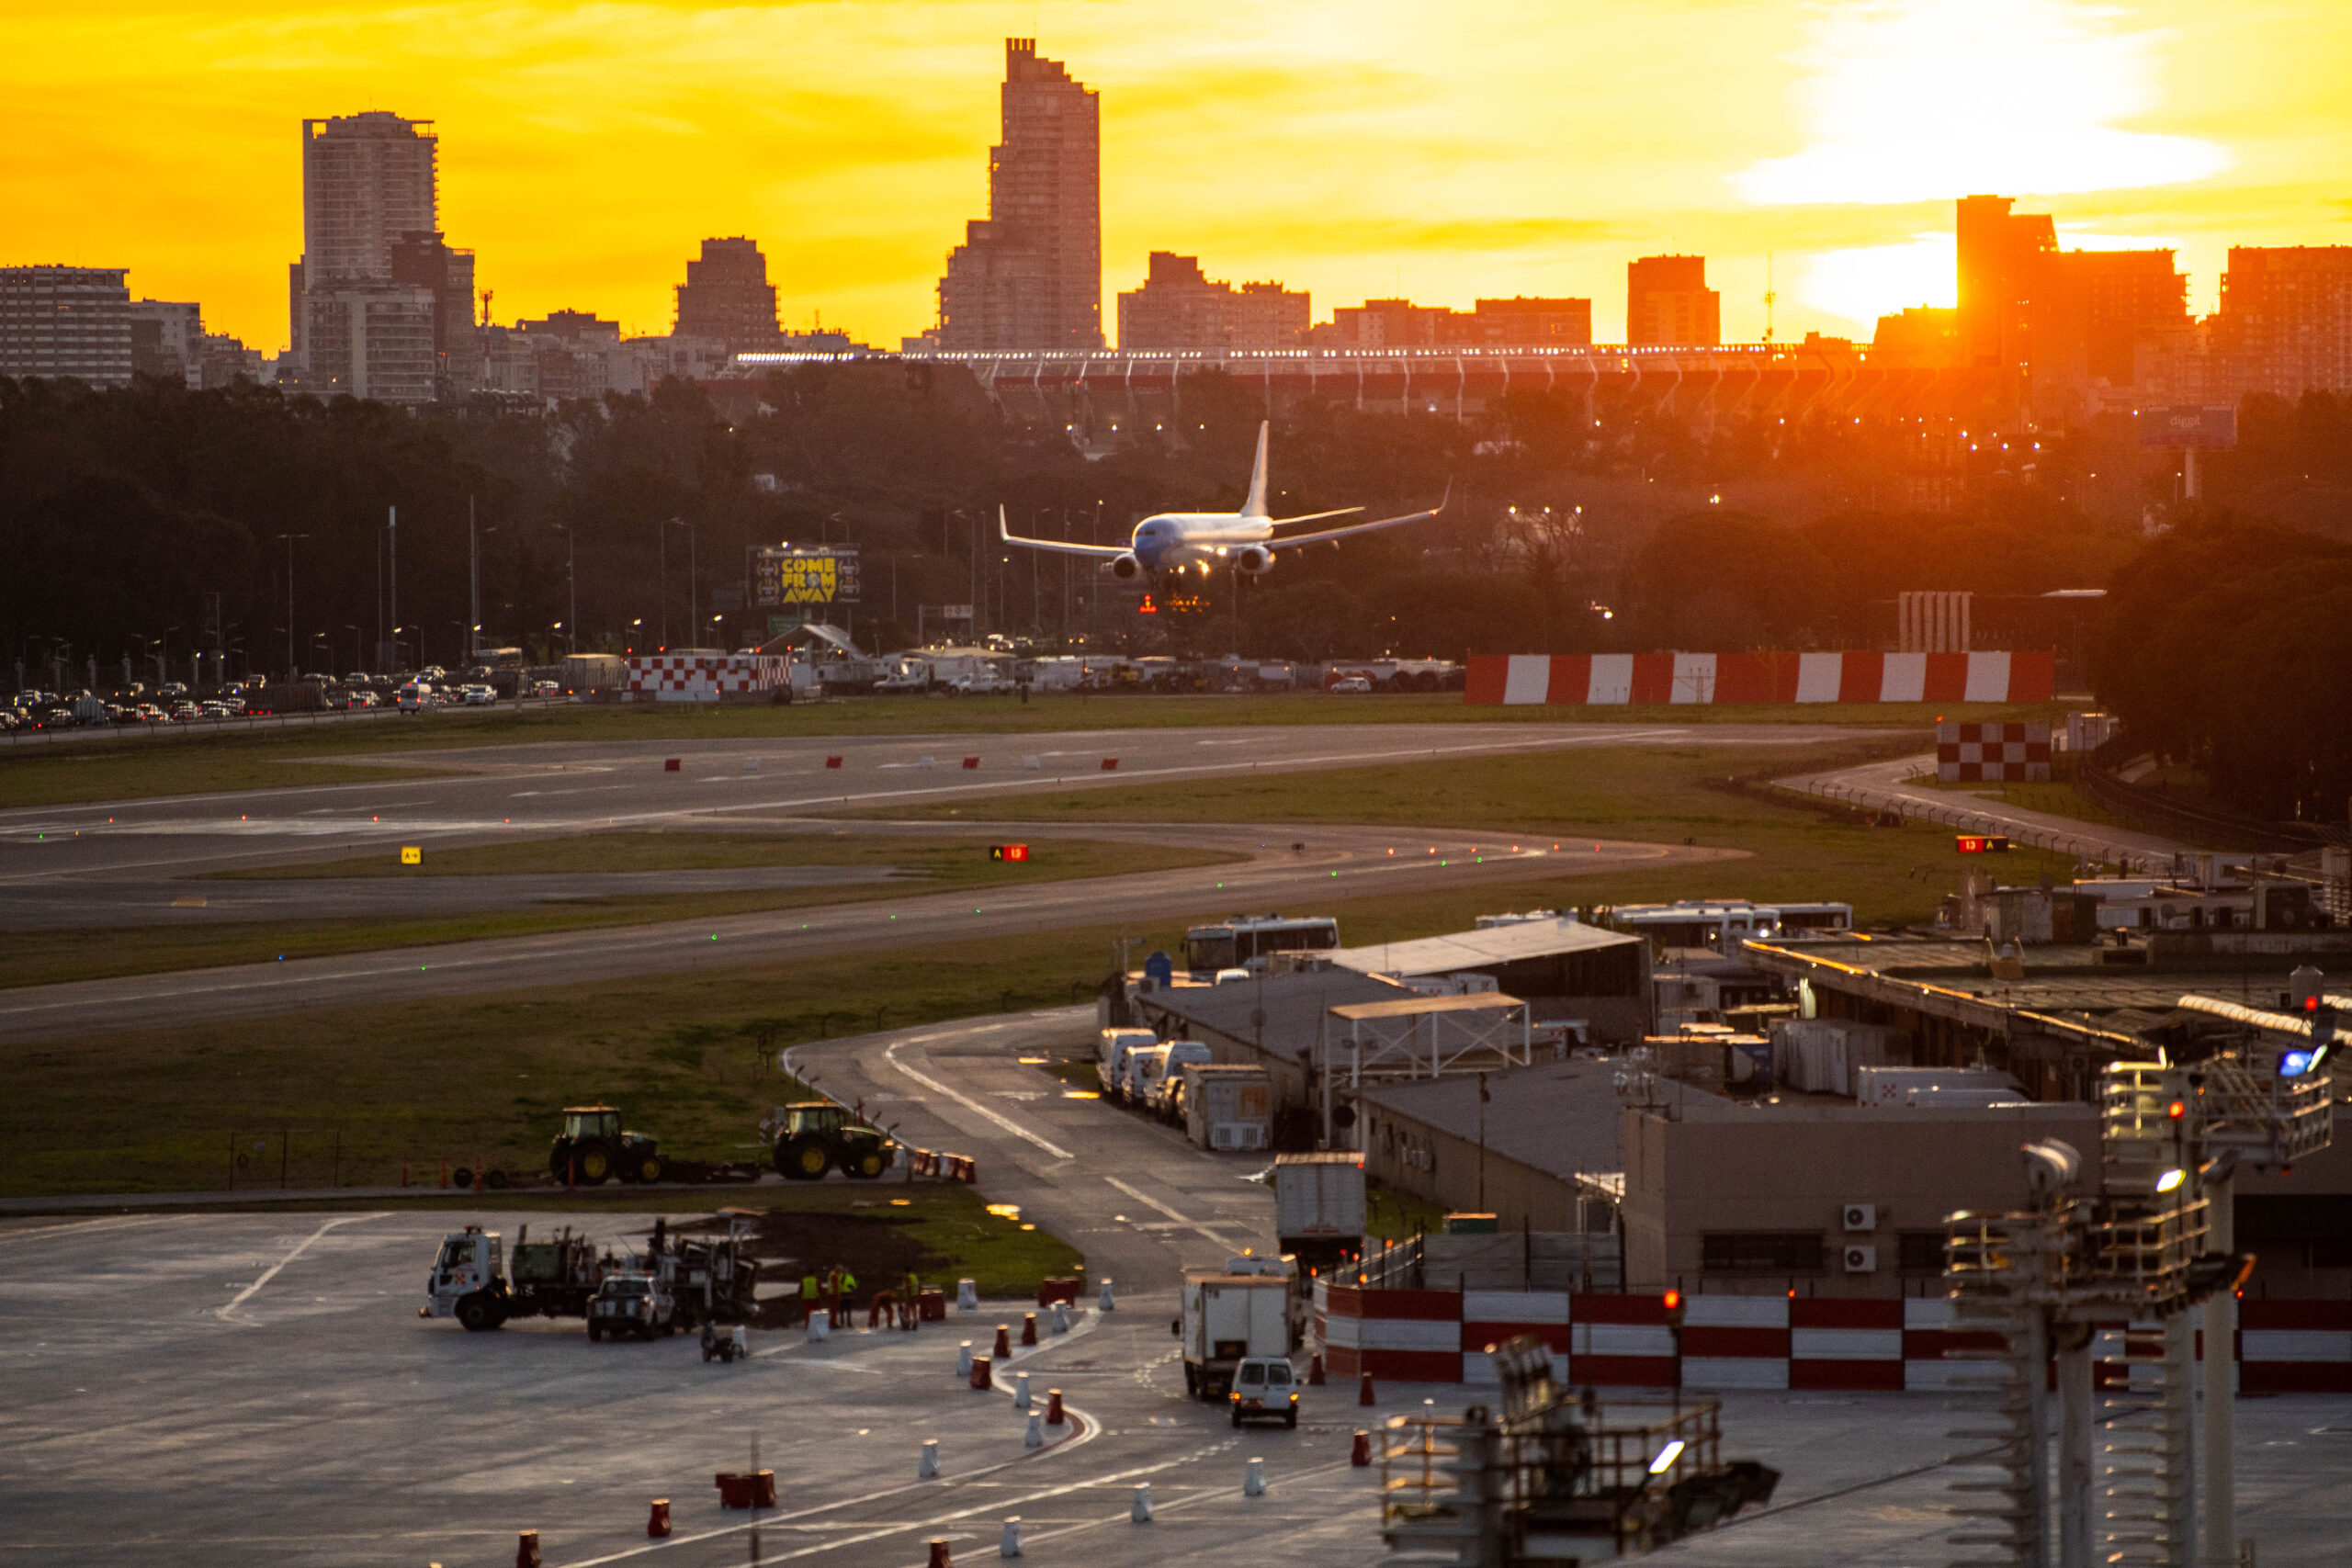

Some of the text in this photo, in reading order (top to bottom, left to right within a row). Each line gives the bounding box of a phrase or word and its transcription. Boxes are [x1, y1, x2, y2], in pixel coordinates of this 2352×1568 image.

[782, 558, 836, 573] COME
[782, 573, 836, 588] FROM
[782, 588, 836, 603] AWAY
[1966, 840, 1994, 850] 13 A
[994, 848, 1001, 859] A
